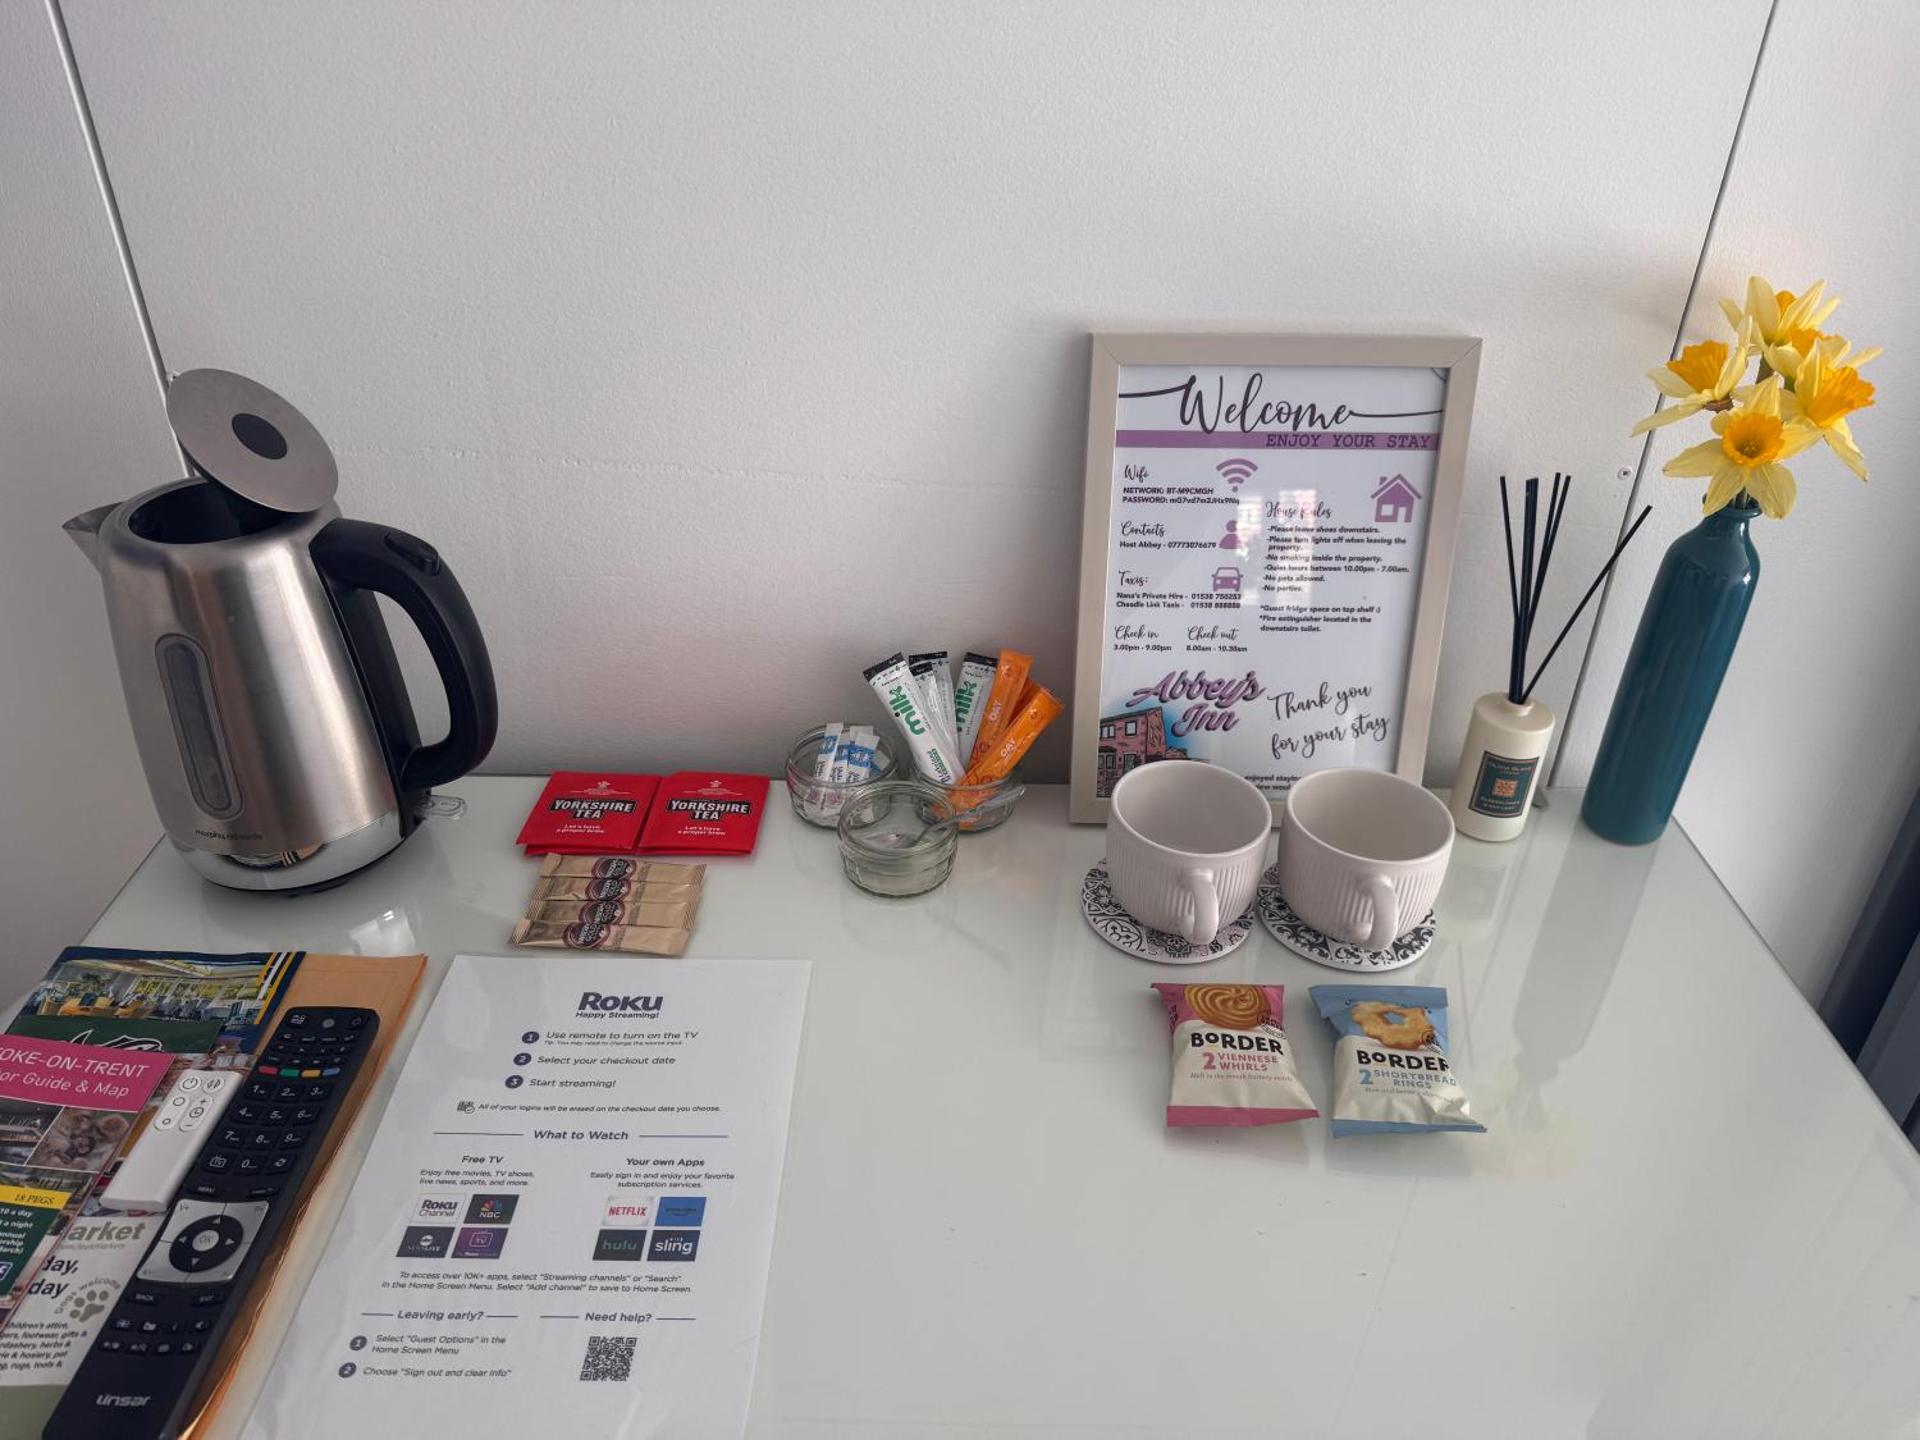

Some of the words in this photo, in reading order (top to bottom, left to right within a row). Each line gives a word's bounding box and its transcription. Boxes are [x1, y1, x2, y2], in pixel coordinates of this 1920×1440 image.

[1175, 372, 1351, 434] Welcome
[1266, 435, 1321, 448] ENJOY
[1332, 435, 1375, 448] YOUR
[1387, 435, 1430, 449] STAY
[1124, 465, 1149, 483] Wifi
[1120, 520, 1165, 537] Contacts
[1138, 541, 1161, 550] Abbey
[1114, 624, 1145, 640] Check
[1187, 626, 1218, 641] Check
[1221, 628, 1239, 641] out
[1125, 670, 1267, 709] Abbey's
[1267, 681, 1332, 721] Thank
[1336, 684, 1372, 715] you
[889, 685, 926, 736] milk
[1171, 704, 1239, 737] Inn
[1271, 733, 1300, 760] for
[1302, 730, 1346, 758] your
[1351, 713, 1391, 742] stay
[554, 800, 634, 812] YORKSHIRE
[670, 800, 750, 814] YORKSHIRE
[575, 809, 601, 819] TEA
[693, 811, 719, 820] TEA
[578, 992, 663, 1011] Roku
[684, 1031, 698, 1039] TV
[1191, 1033, 1284, 1056] BORDER
[0, 1048, 150, 1078] OKE-ON-TRENT
[537, 1056, 571, 1064] Select
[573, 1057, 597, 1065] your
[600, 1057, 648, 1065] checkout
[651, 1057, 676, 1065] date
[1202, 1052, 1216, 1070] 2
[1218, 1053, 1278, 1063] VIENNESE
[1219, 1062, 1268, 1071] WHIRLS
[1359, 1069, 1374, 1084] 2
[1374, 1070, 1456, 1086] SHORTBREAD
[1393, 1079, 1432, 1088] RINGS
[0, 1071, 20, 1082] or
[23, 1072, 72, 1091] Guide
[75, 1079, 90, 1093] &
[94, 1082, 129, 1098] Map
[529, 1079, 556, 1087] Start
[559, 1079, 616, 1089] streaming!
[533, 1130, 568, 1140] What
[571, 1131, 584, 1140] to
[588, 1130, 629, 1141] Watch
[461, 1155, 485, 1163] Free
[489, 1156, 504, 1164] TV
[626, 1158, 650, 1166] Your
[677, 1159, 705, 1167] Apps
[615, 1172, 632, 1180] sign
[617, 1181, 667, 1189] subscription
[421, 1199, 458, 1210] Roku
[419, 1208, 455, 1217] Channel
[608, 1207, 648, 1216] NETFLIX
[66, 1221, 147, 1242] arket
[602, 1239, 637, 1250] hulu
[655, 1238, 693, 1255] sling
[28, 1279, 69, 1299] day
[397, 1310, 444, 1321] Leaving
[447, 1311, 484, 1321] early?
[585, 1312, 617, 1322] Need
[620, 1313, 652, 1324] help?
[375, 1334, 403, 1342] Select
[372, 1346, 399, 1354] Home
[434, 1347, 460, 1355] Menu
[363, 1367, 398, 1376] Choose
[445, 1369, 462, 1377] and
[464, 1369, 487, 1377] clear
